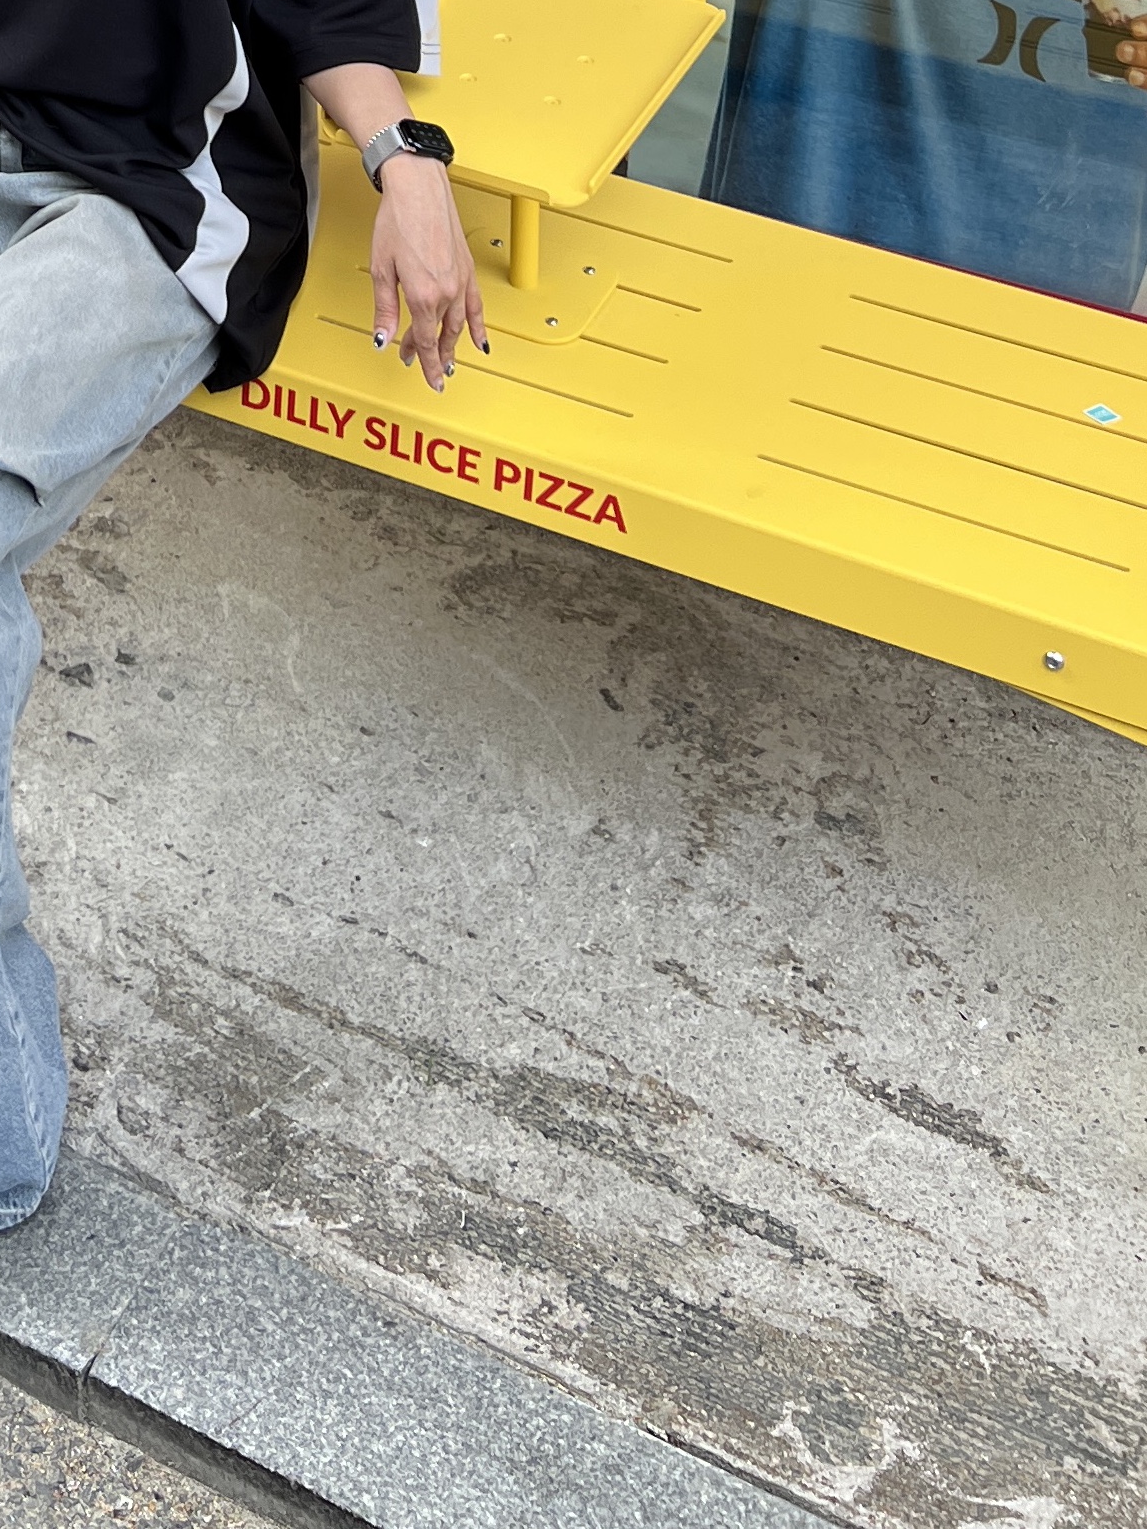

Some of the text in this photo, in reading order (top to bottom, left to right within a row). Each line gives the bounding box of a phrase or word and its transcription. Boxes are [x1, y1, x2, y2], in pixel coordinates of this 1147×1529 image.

[241, 379, 628, 534] DILLY SLICE PIZZA
